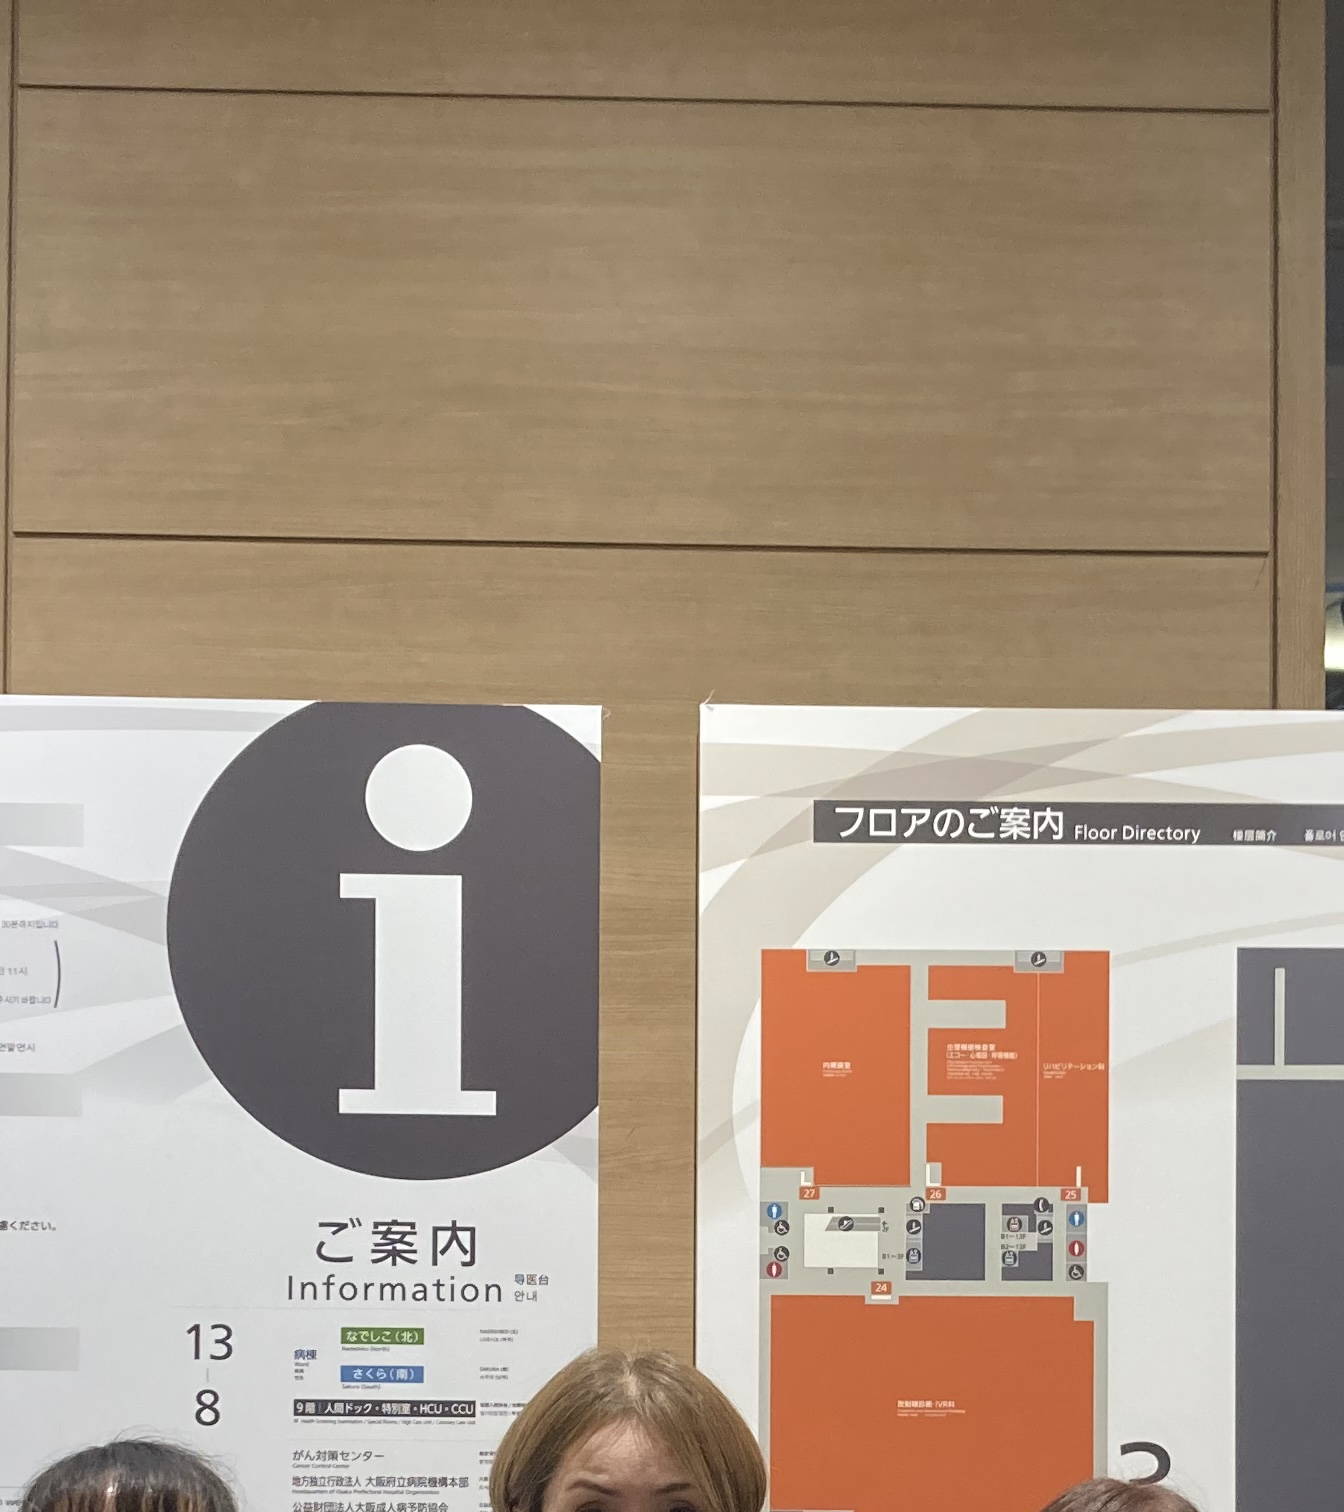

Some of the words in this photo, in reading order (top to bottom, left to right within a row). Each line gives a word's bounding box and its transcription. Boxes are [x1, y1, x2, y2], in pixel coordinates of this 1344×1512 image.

[834, 806, 1064, 841] フロアのご案内
[1074, 825, 1117, 842] Floor
[1122, 825, 1201, 845] Directory
[929, 1189, 943, 1200] 26
[1064, 1190, 1077, 1200] 25
[315, 1216, 477, 1267] ご案内
[286, 1273, 503, 1303] Information
[875, 1282, 888, 1293] 24
[513, 1289, 539, 1303] 안내
[186, 1322, 234, 1362] 13
[293, 1349, 318, 1361] 病棟
[194, 1388, 222, 1427] 8
[292, 1449, 385, 1462] がん対策センター
